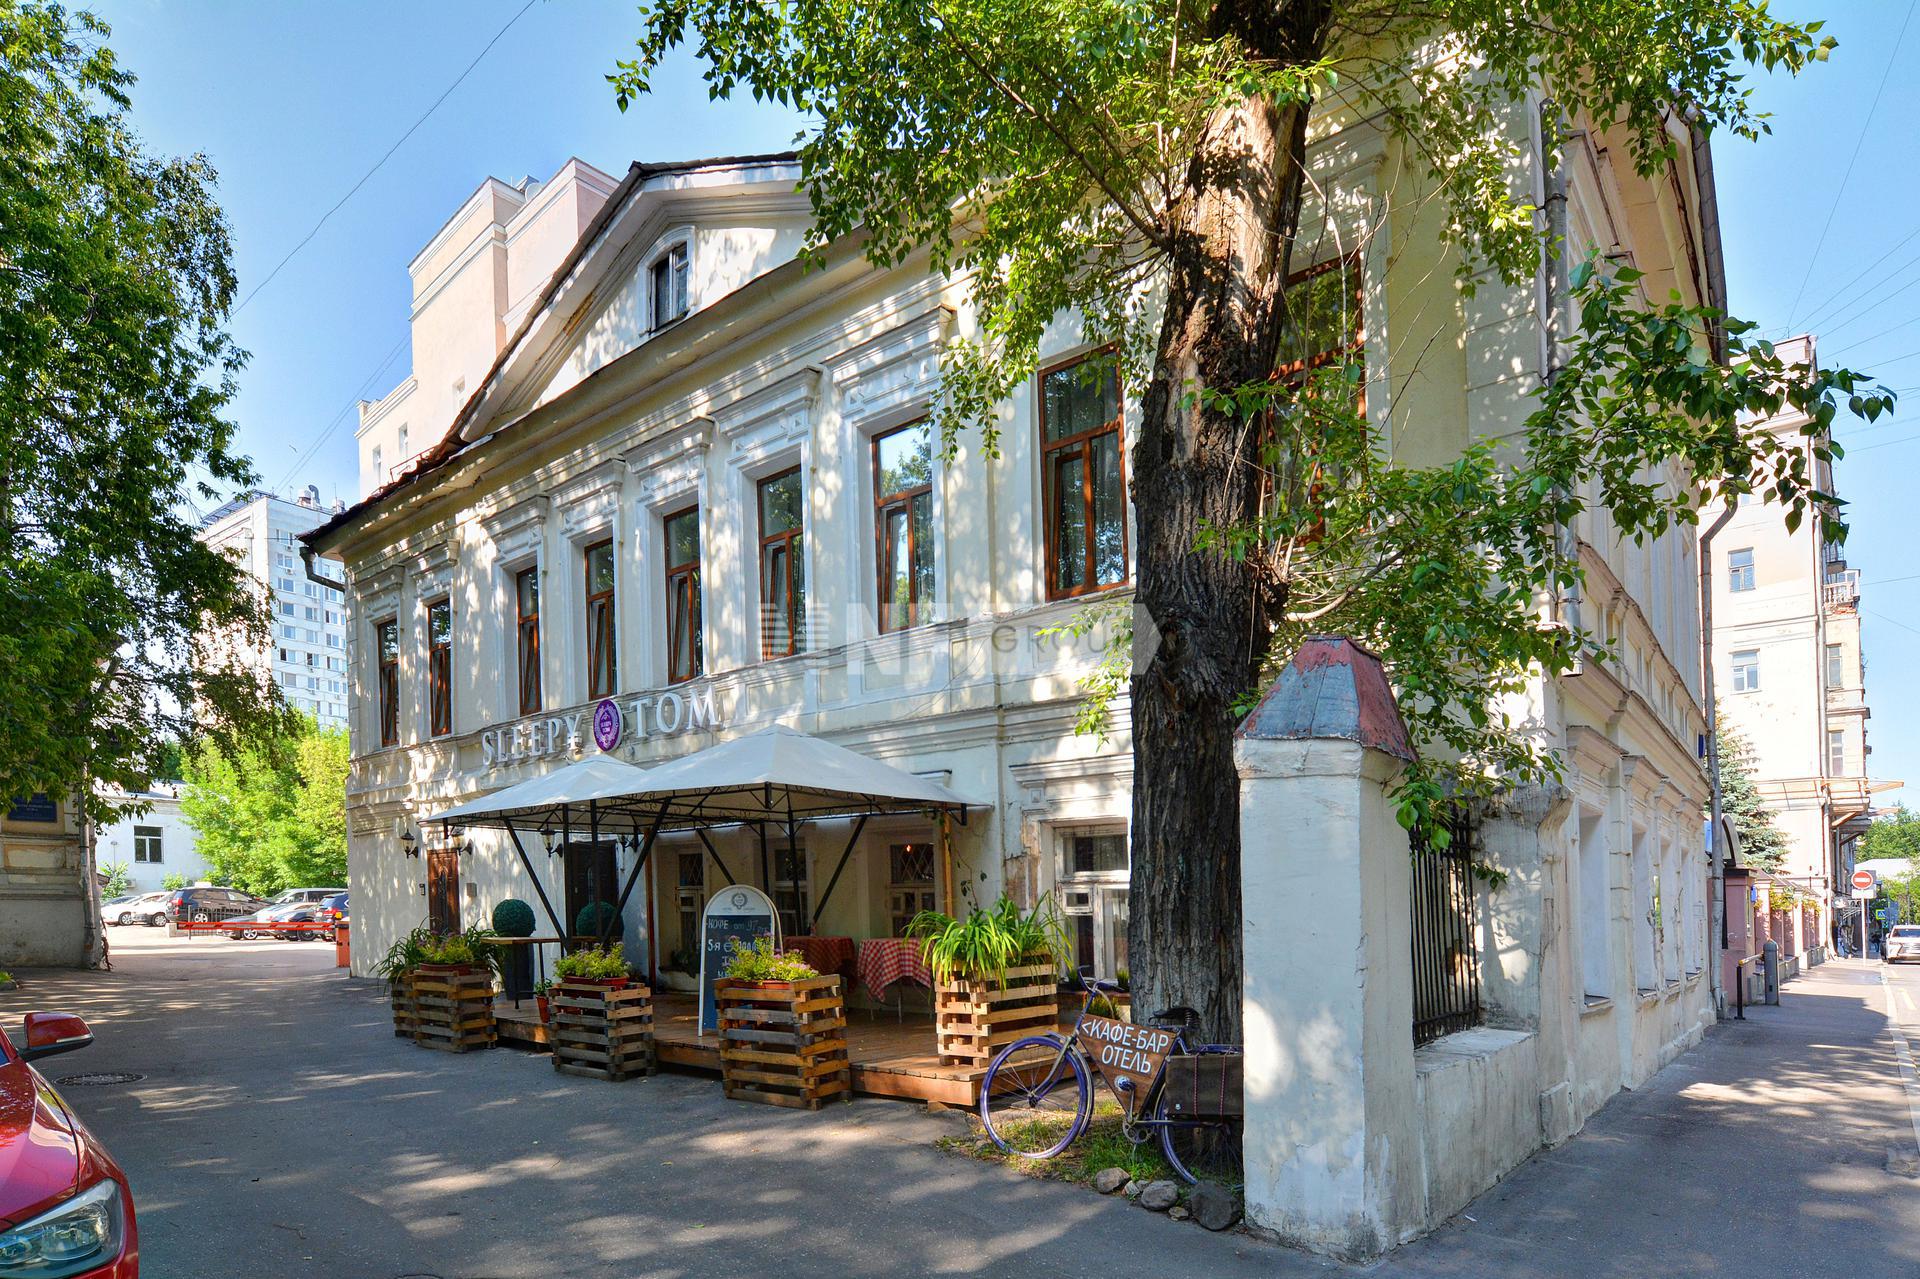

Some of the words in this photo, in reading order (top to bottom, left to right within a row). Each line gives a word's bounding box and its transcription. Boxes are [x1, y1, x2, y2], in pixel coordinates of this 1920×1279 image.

[481, 713, 582, 766] SLEEPY
[629, 684, 720, 738] TOM
[1101, 1044, 1152, 1074] ОТЕЛЬ
